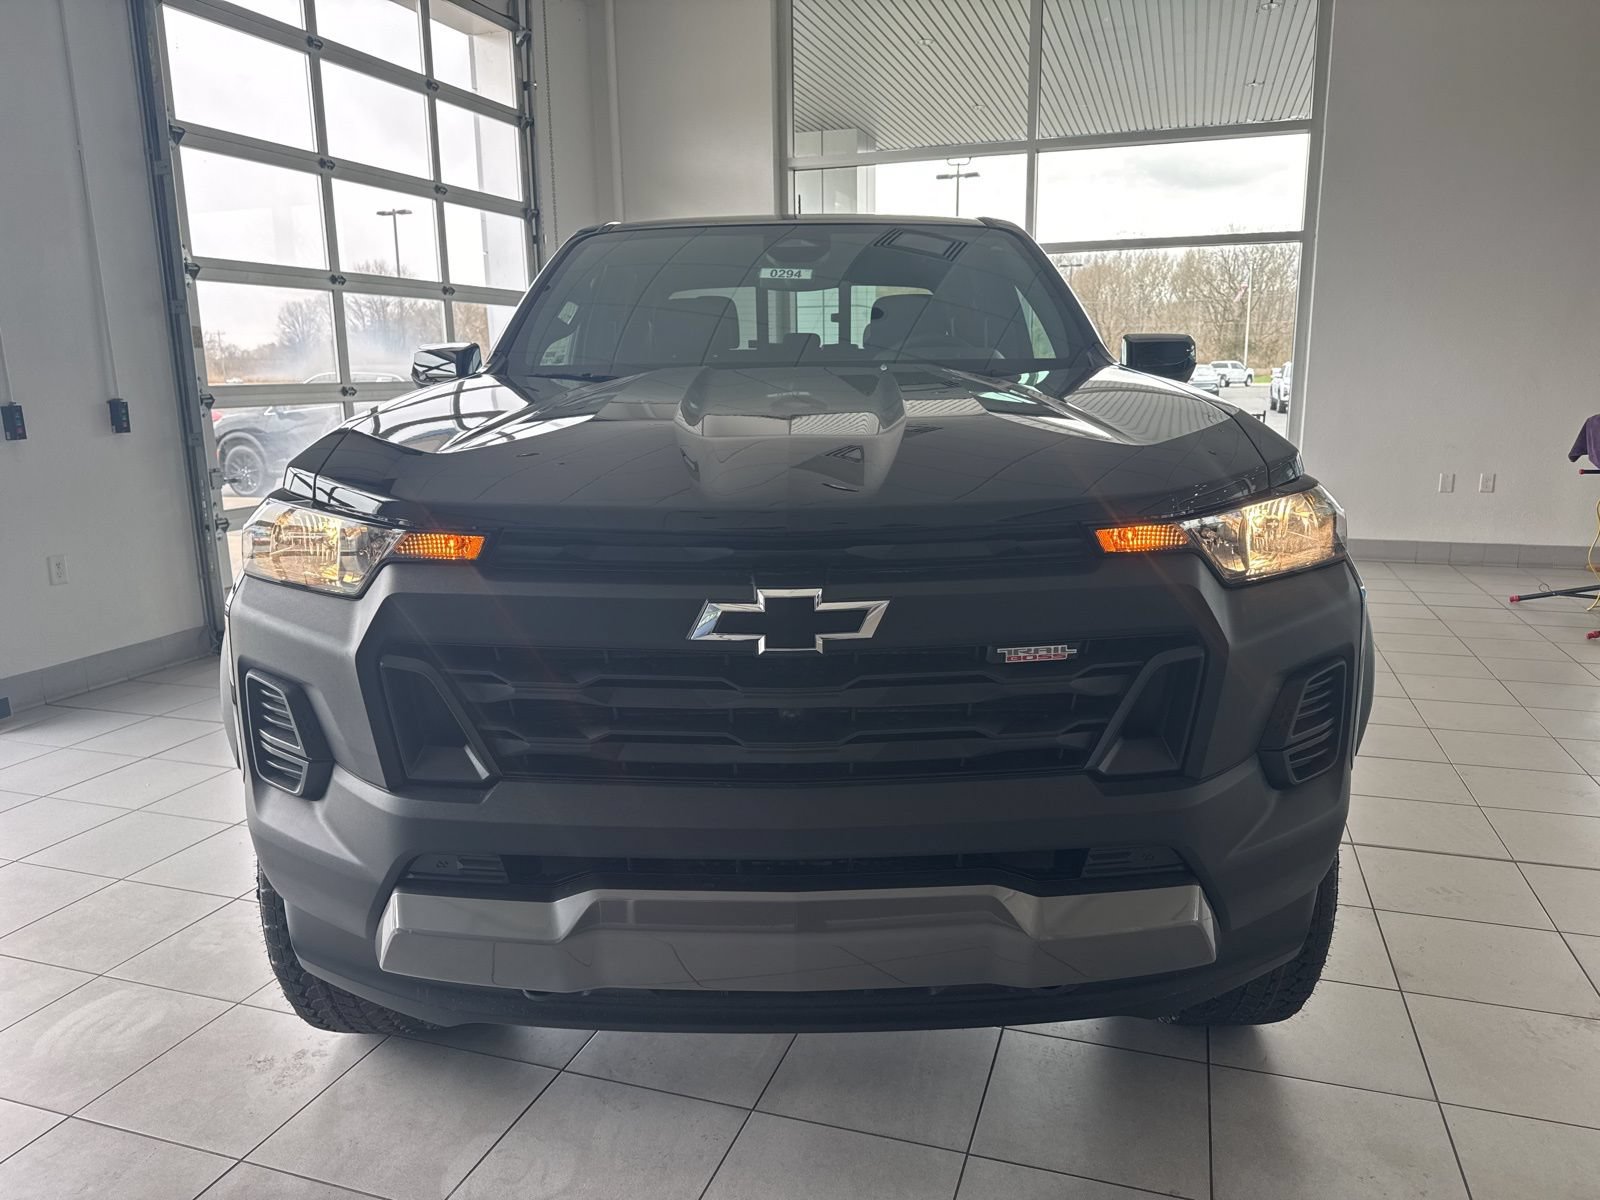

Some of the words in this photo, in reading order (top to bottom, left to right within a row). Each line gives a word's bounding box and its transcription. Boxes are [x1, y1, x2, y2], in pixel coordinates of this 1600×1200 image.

[770, 269, 802, 278] 0294
[997, 645, 1077, 656] TRAIL
[1006, 653, 1067, 663] BOSS
